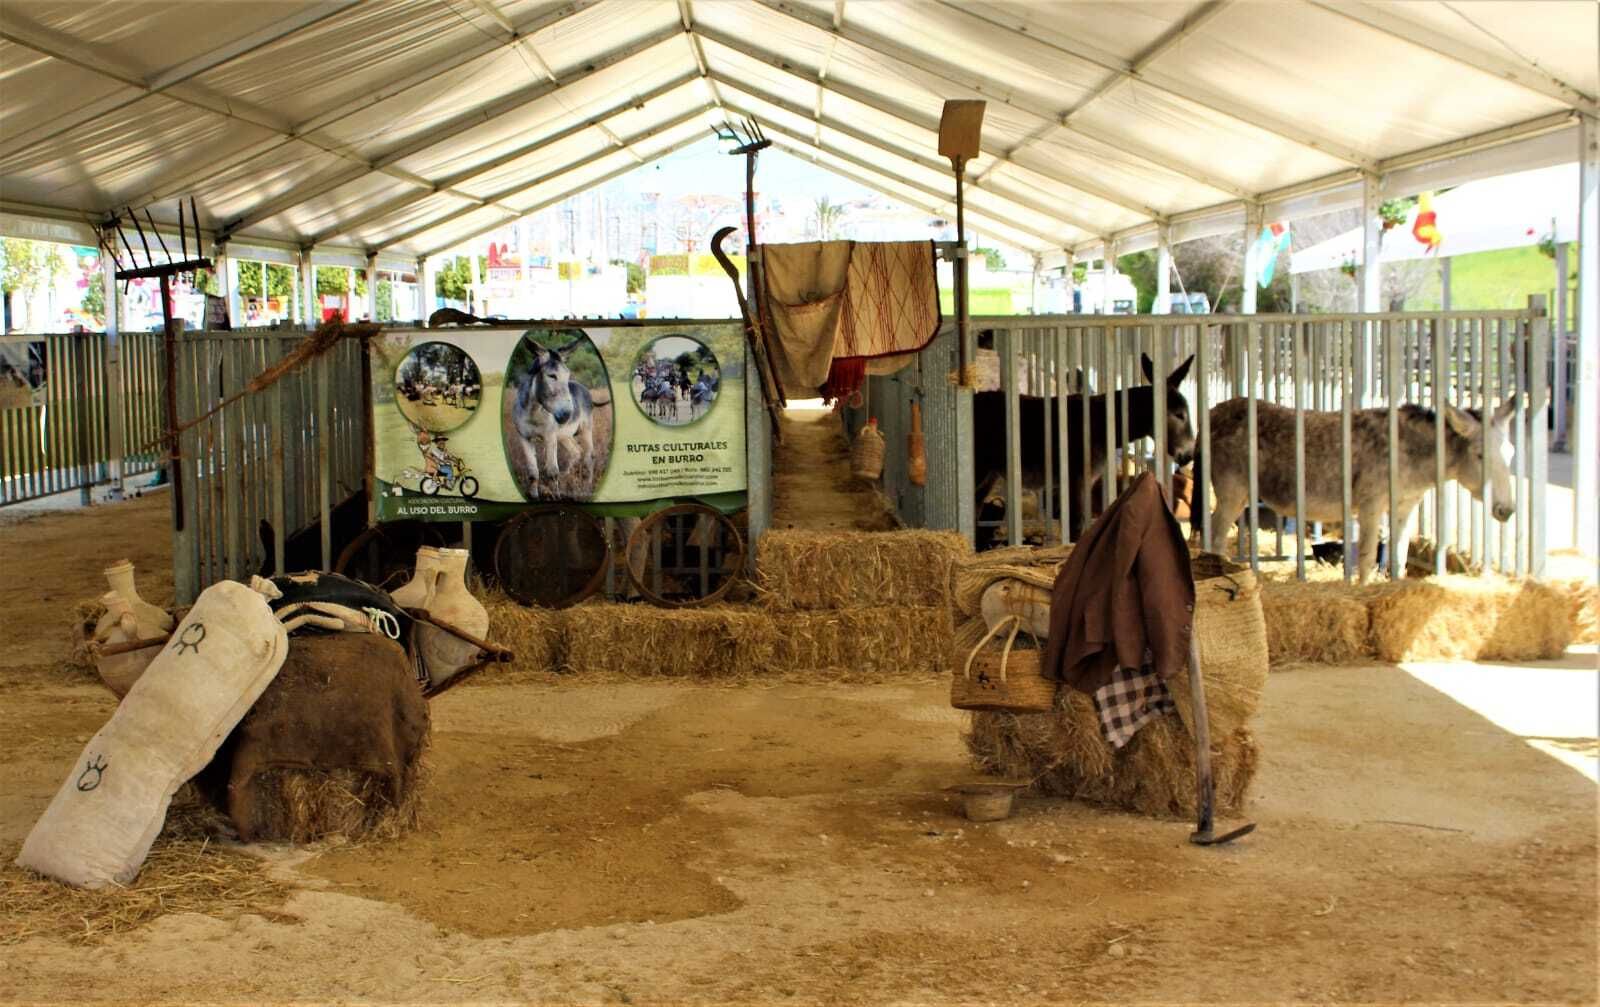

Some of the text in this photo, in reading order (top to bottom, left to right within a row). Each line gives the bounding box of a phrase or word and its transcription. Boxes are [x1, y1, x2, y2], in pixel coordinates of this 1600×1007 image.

[627, 441, 728, 453] RUTAS CULTURALES
[652, 454, 704, 464] EN BURRO
[397, 506, 408, 514] AL
[430, 506, 446, 514] DEL
[448, 506, 478, 514] BURRO
